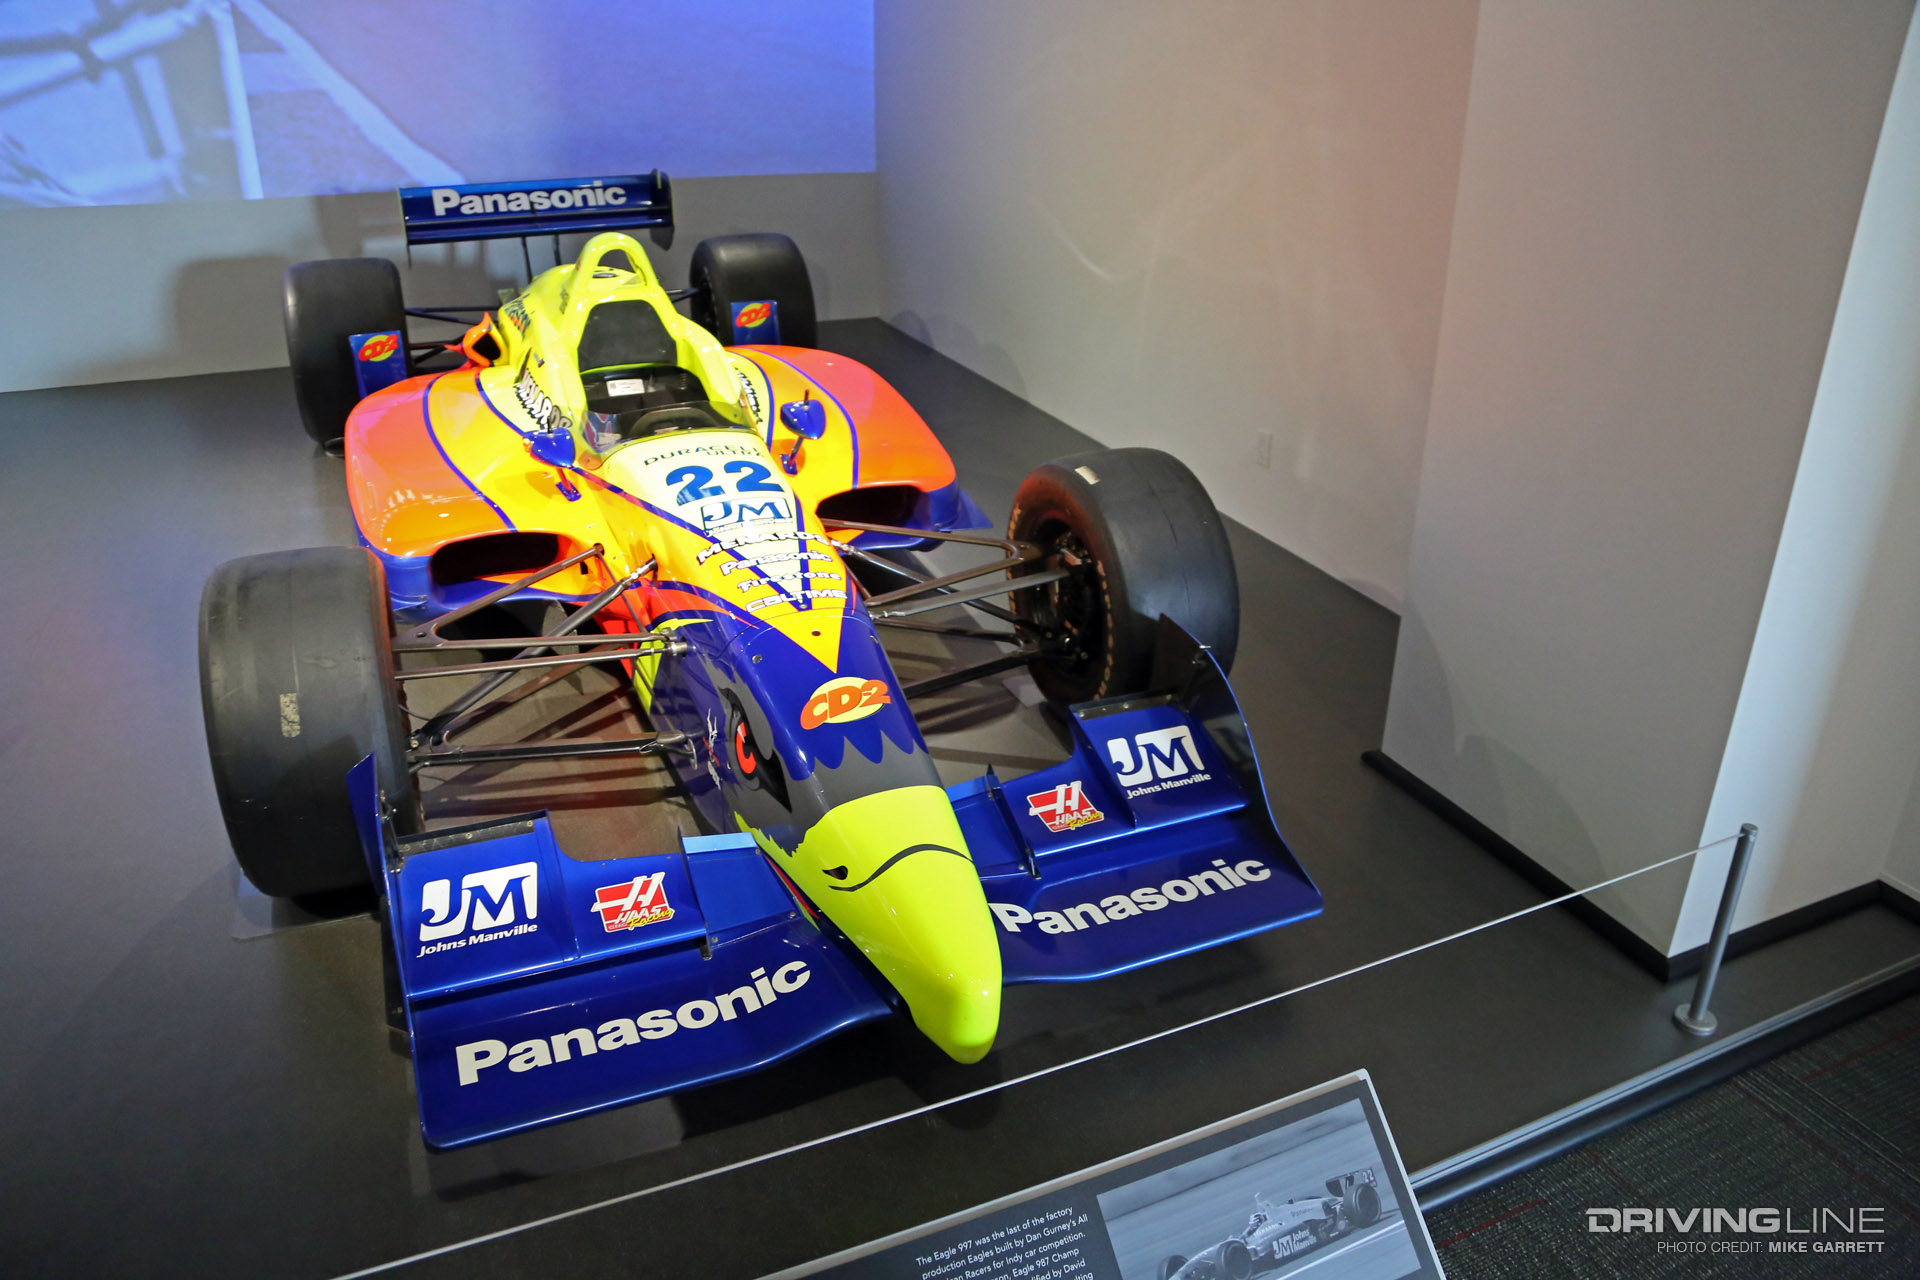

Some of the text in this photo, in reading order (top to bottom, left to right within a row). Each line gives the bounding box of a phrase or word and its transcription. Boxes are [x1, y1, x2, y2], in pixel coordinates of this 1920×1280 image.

[432, 180, 627, 216] Panasonic
[665, 460, 784, 506] 22
[696, 531, 830, 565] MENARDS
[720, 550, 833, 576] Panasonic
[737, 571, 842, 593] Firestone
[1107, 725, 1205, 787] JM
[1127, 773, 1212, 799] Johns Manville
[419, 861, 538, 942] JM
[988, 859, 1272, 935] Panasonic
[416, 923, 538, 958] Johns Manville
[455, 960, 811, 1086] Panasonic
[916, 1207, 1073, 1267] The Eagle 997 was the last of the factory
[922, 1213, 1089, 1280] production Eagles built by Dan Gurney's All
[1293, 1229, 1310, 1242] Johns
[965, 1265, 992, 1280] Racers
[992, 1260, 1004, 1270] for
[1005, 1253, 1023, 1265] Indy
[1024, 1248, 1037, 1258] car
[1038, 1232, 1086, 1253] competition.
[1012, 1263, 1035, 1277] Eagle
[1035, 1256, 1049, 1268] 987
[1051, 1248, 1080, 1263] Champ
[1052, 1267, 1062, 1278] by
[1063, 1257, 1086, 1273] David
